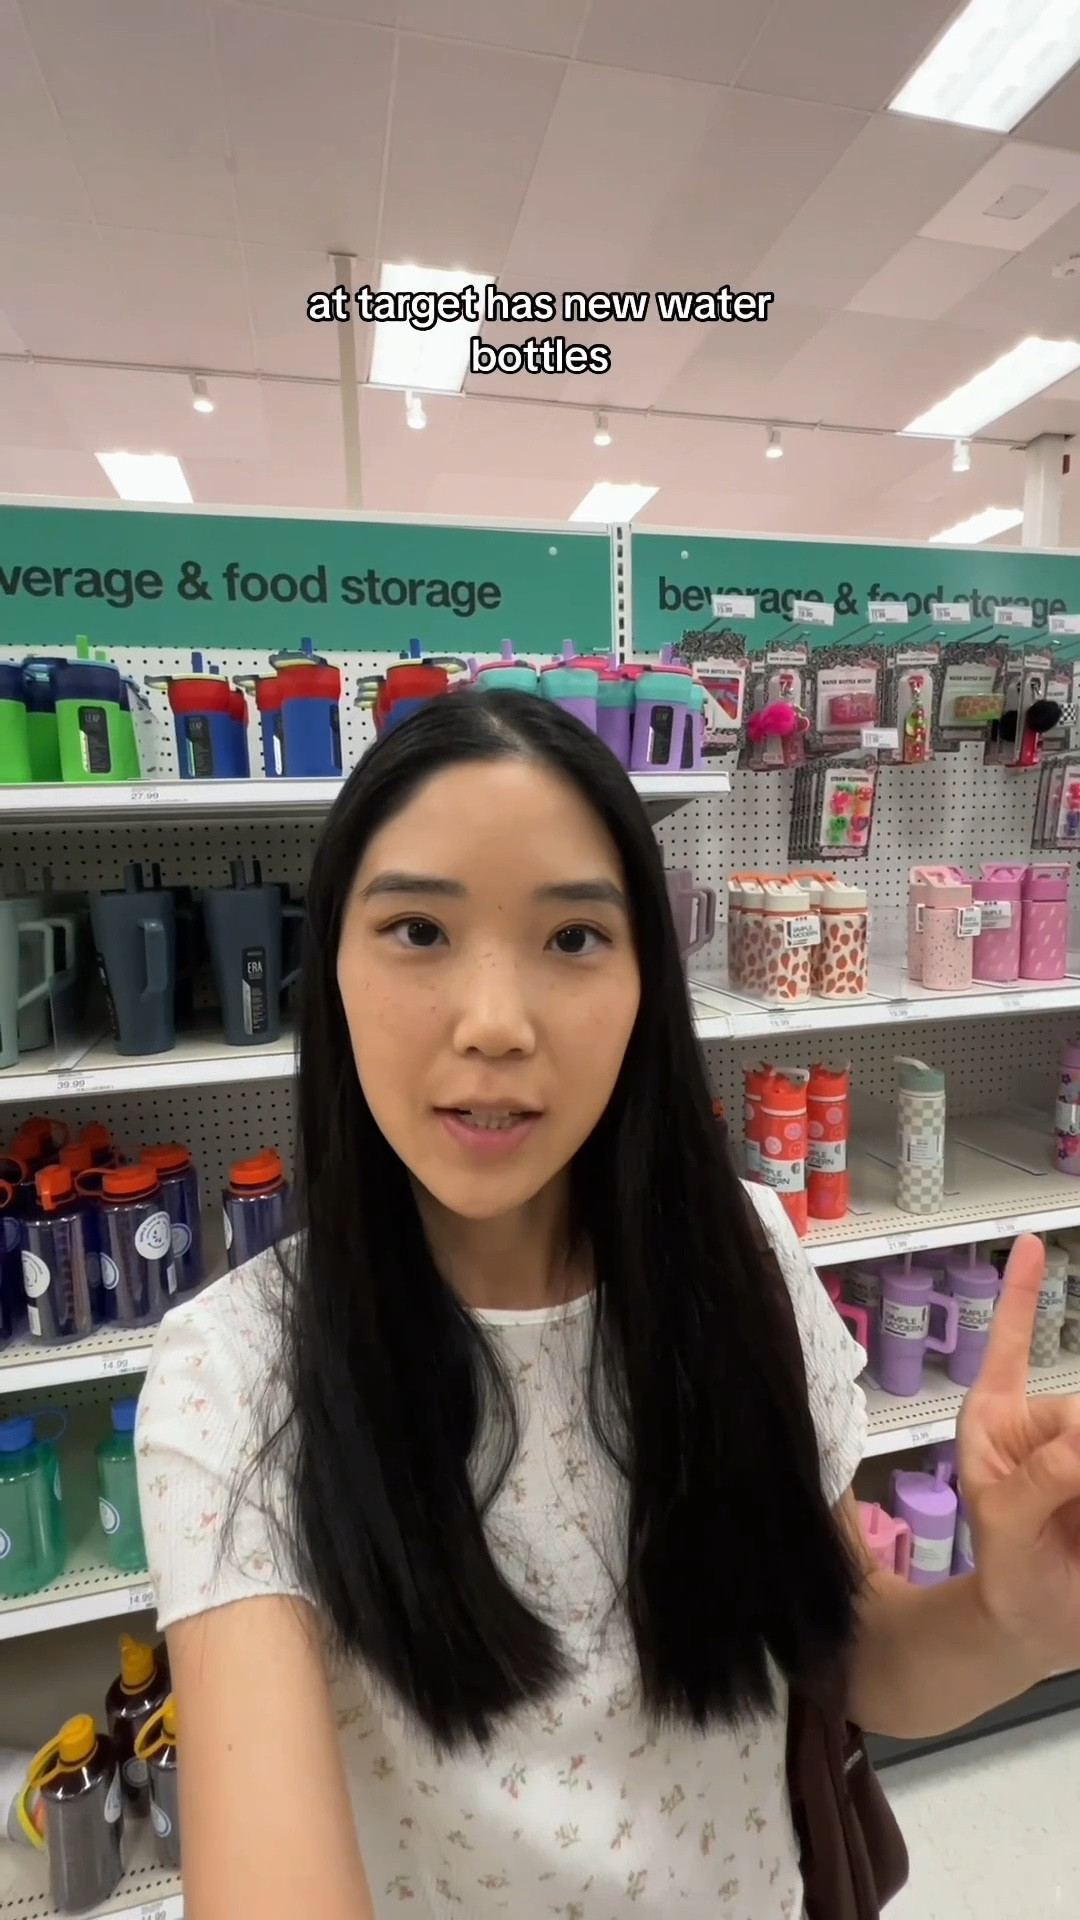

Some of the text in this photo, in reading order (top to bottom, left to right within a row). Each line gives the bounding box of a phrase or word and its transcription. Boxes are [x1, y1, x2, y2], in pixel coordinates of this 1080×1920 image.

[177, 560, 213, 601] &
[222, 562, 328, 604] food
[341, 569, 501, 618] storage
[834, 582, 859, 616] &
[247, 961, 263, 974] ERA
[57, 1079, 86, 1090] 39.99
[103, 1360, 128, 1370] 14.99
